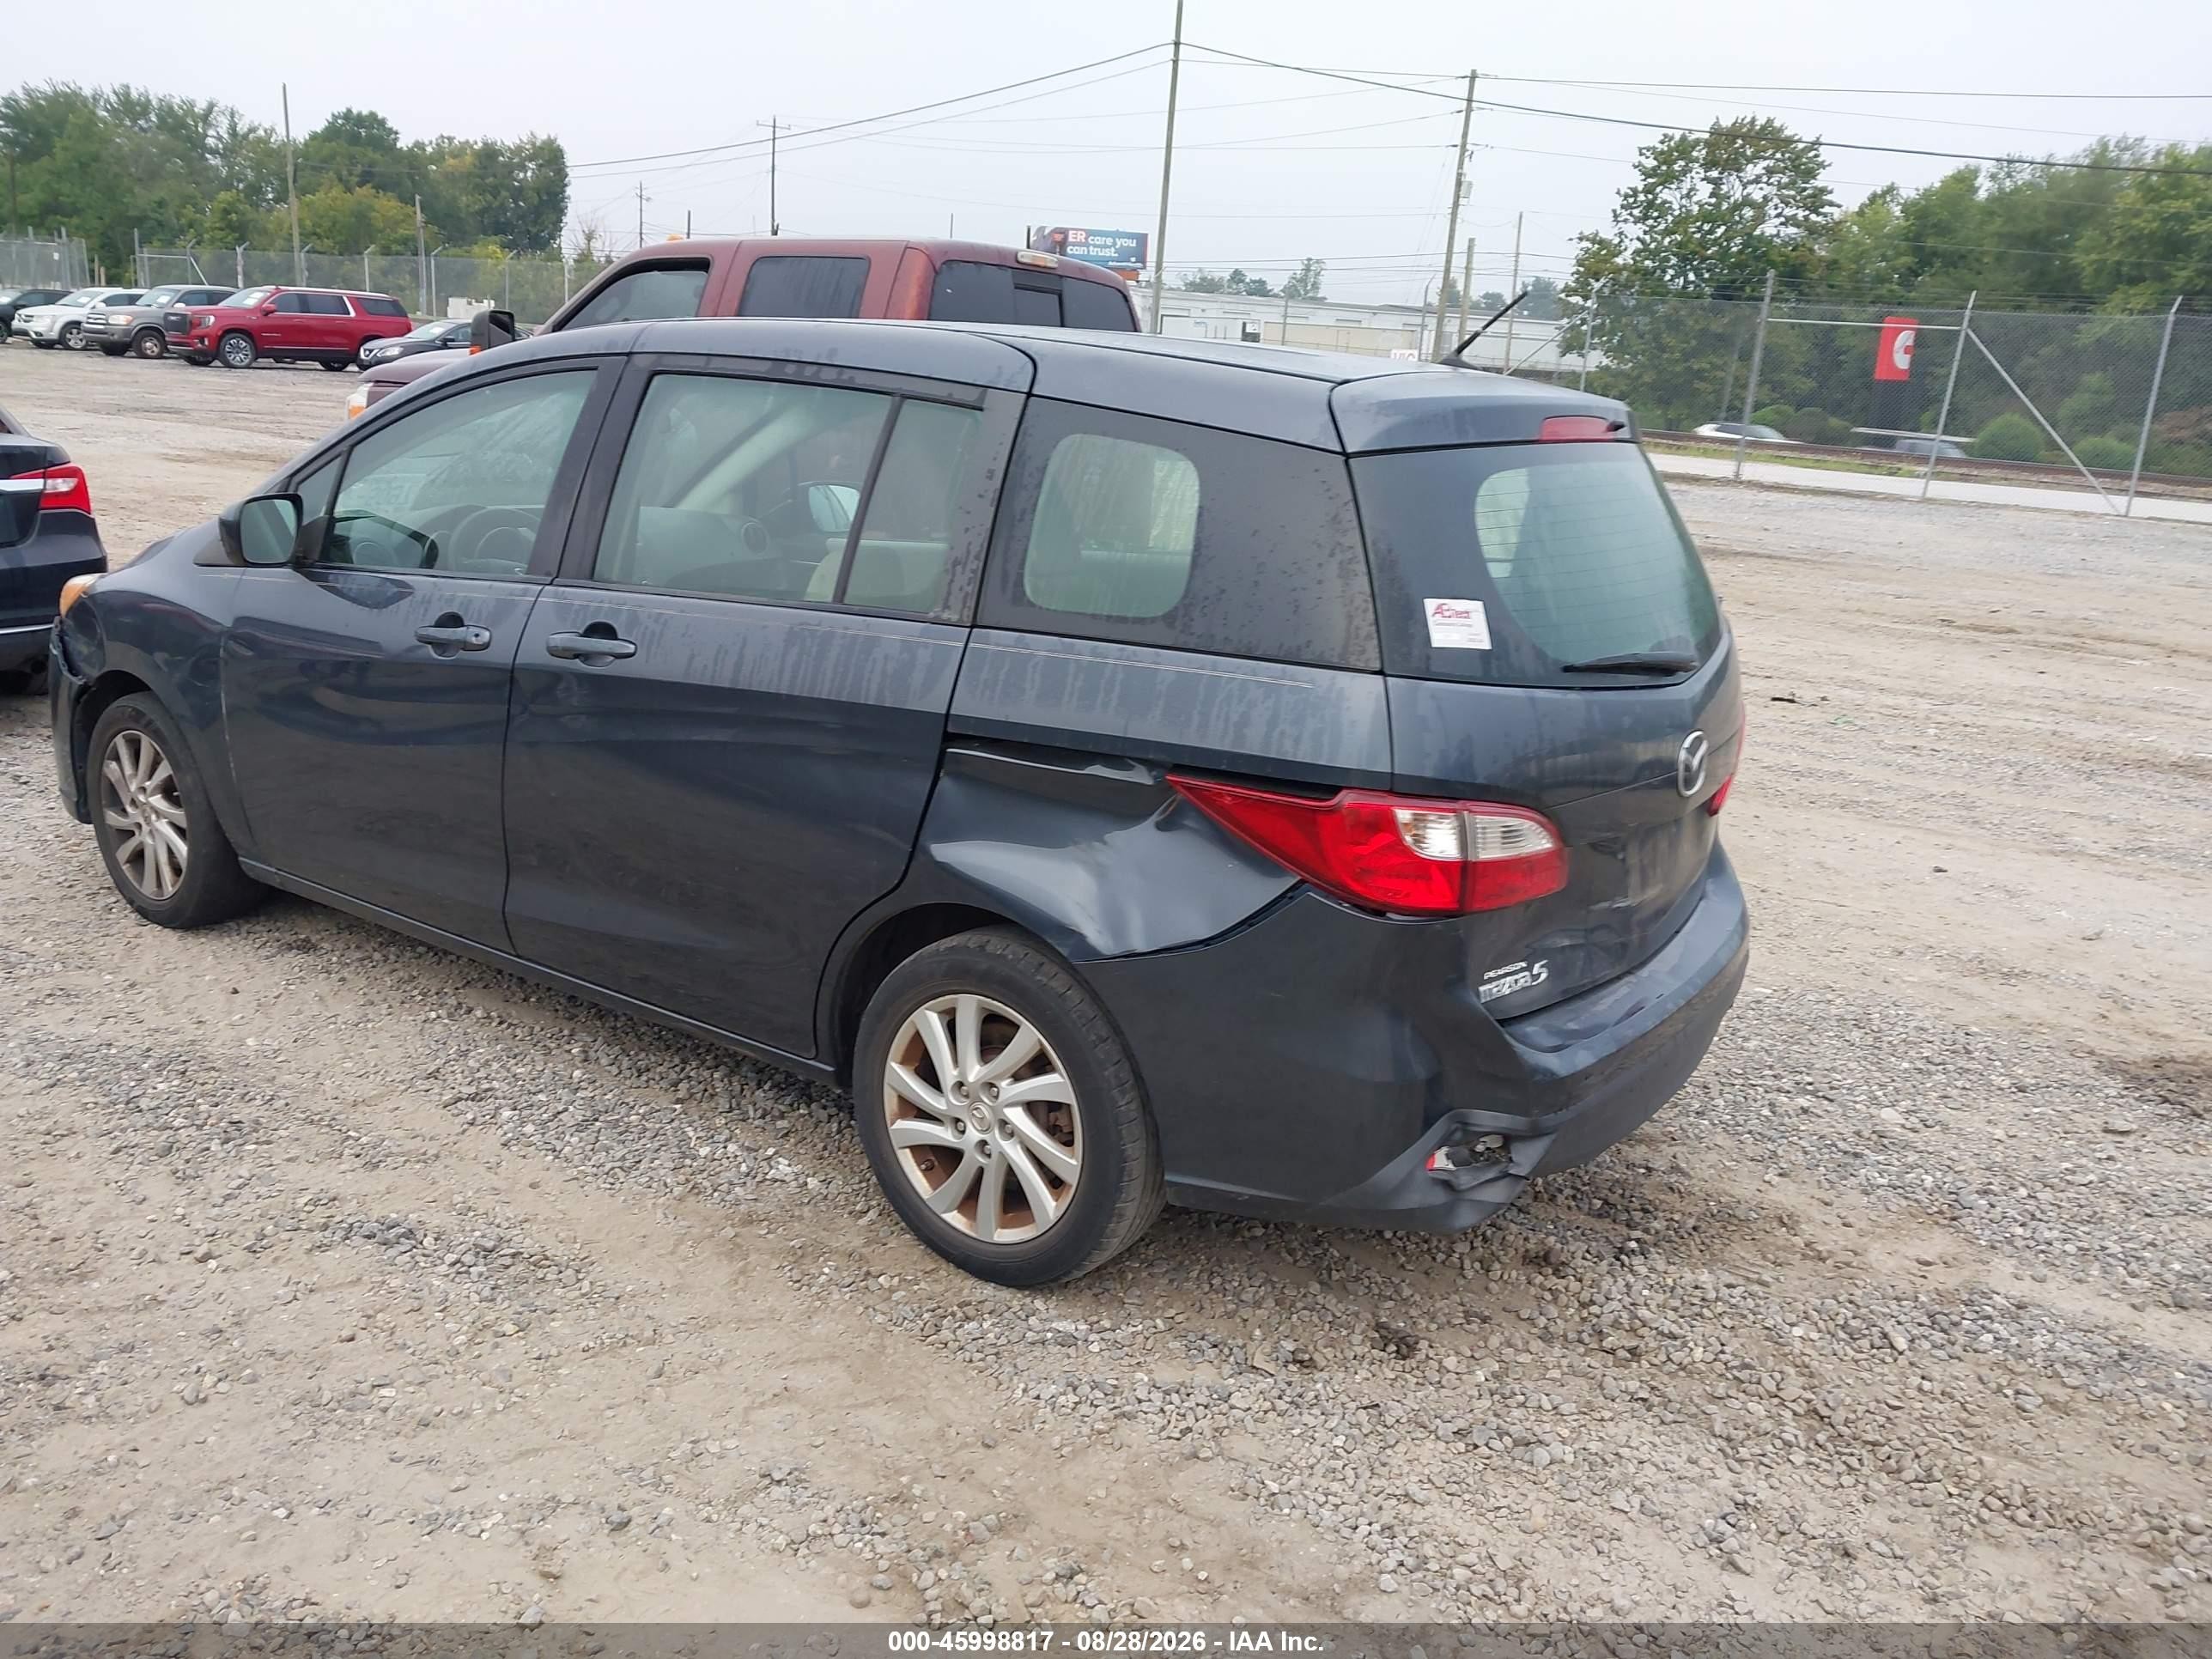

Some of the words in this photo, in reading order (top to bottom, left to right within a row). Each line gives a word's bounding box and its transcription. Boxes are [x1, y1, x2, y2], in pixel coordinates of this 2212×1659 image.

[1068, 230, 1086, 242] ER
[1088, 235, 1113, 246] care
[1115, 237, 1137, 248] you
[1066, 245, 1088, 255] can
[1090, 246, 1119, 257] trust.
